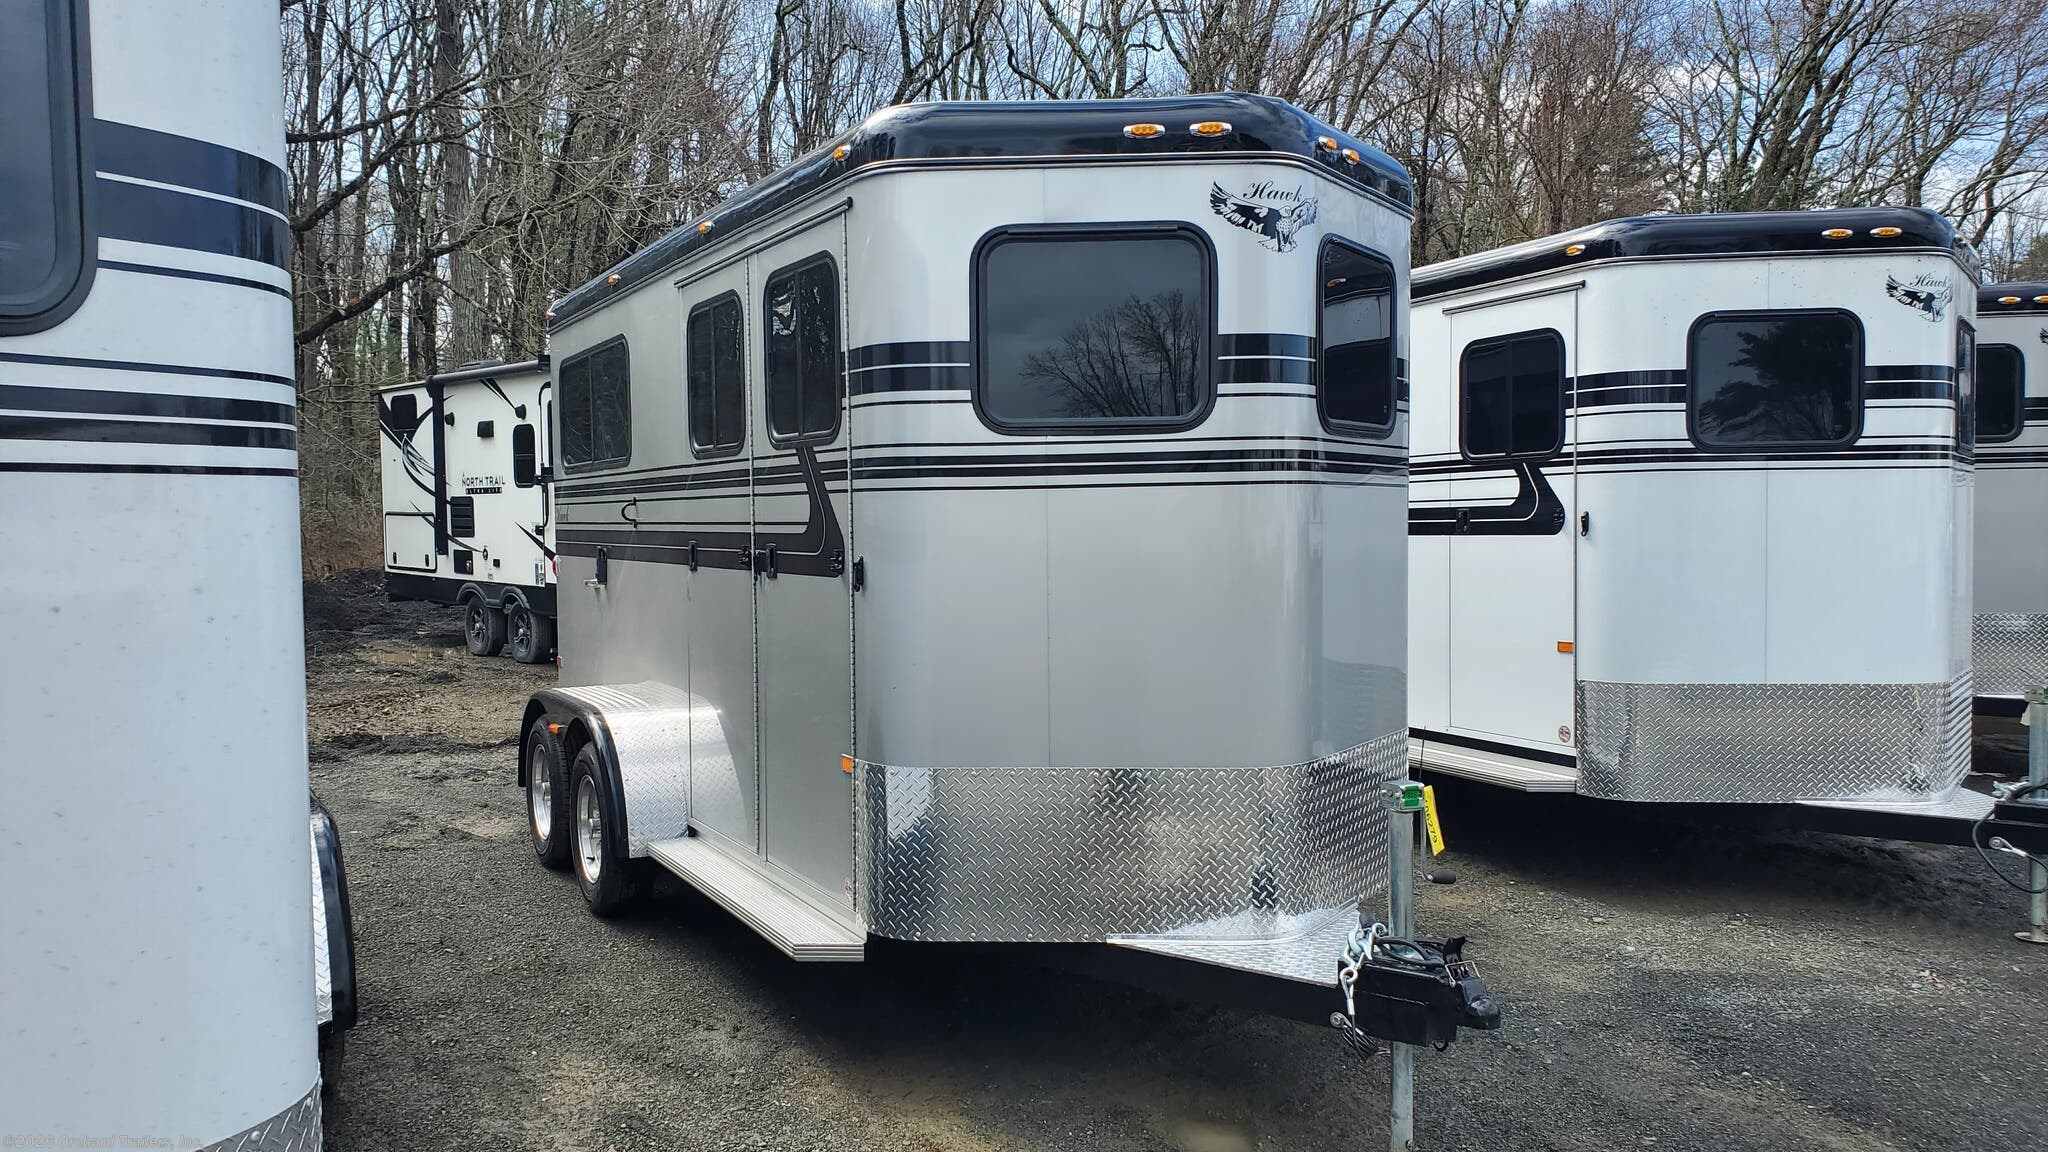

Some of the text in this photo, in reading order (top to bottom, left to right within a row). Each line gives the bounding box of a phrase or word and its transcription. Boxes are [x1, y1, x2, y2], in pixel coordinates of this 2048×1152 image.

[1243, 180, 1302, 202] Hawk
[1909, 270, 1948, 288] Hawk
[461, 472, 506, 487] NORTH TRAIL
